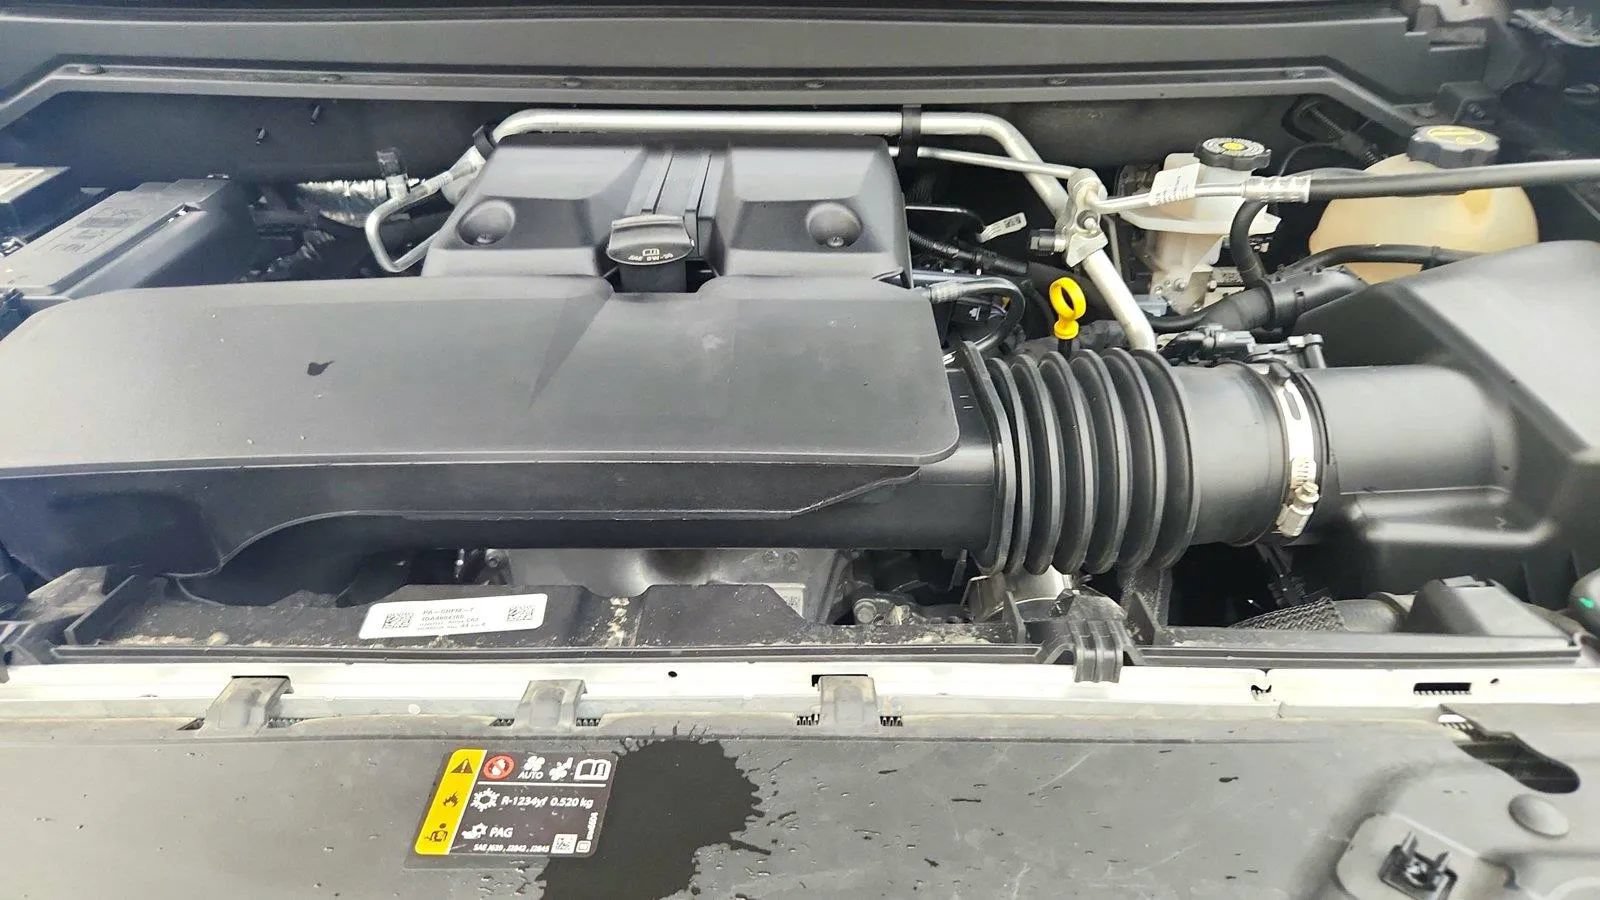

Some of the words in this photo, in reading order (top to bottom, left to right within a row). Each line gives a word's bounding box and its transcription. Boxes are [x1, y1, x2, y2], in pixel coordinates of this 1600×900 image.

[517, 770, 544, 779] AUTO
[501, 795, 549, 808] R-1234yf
[549, 796, 579, 807] 0.520
[579, 797, 594, 809] kg
[489, 826, 514, 838] PAG
[473, 843, 488, 852] SAE
